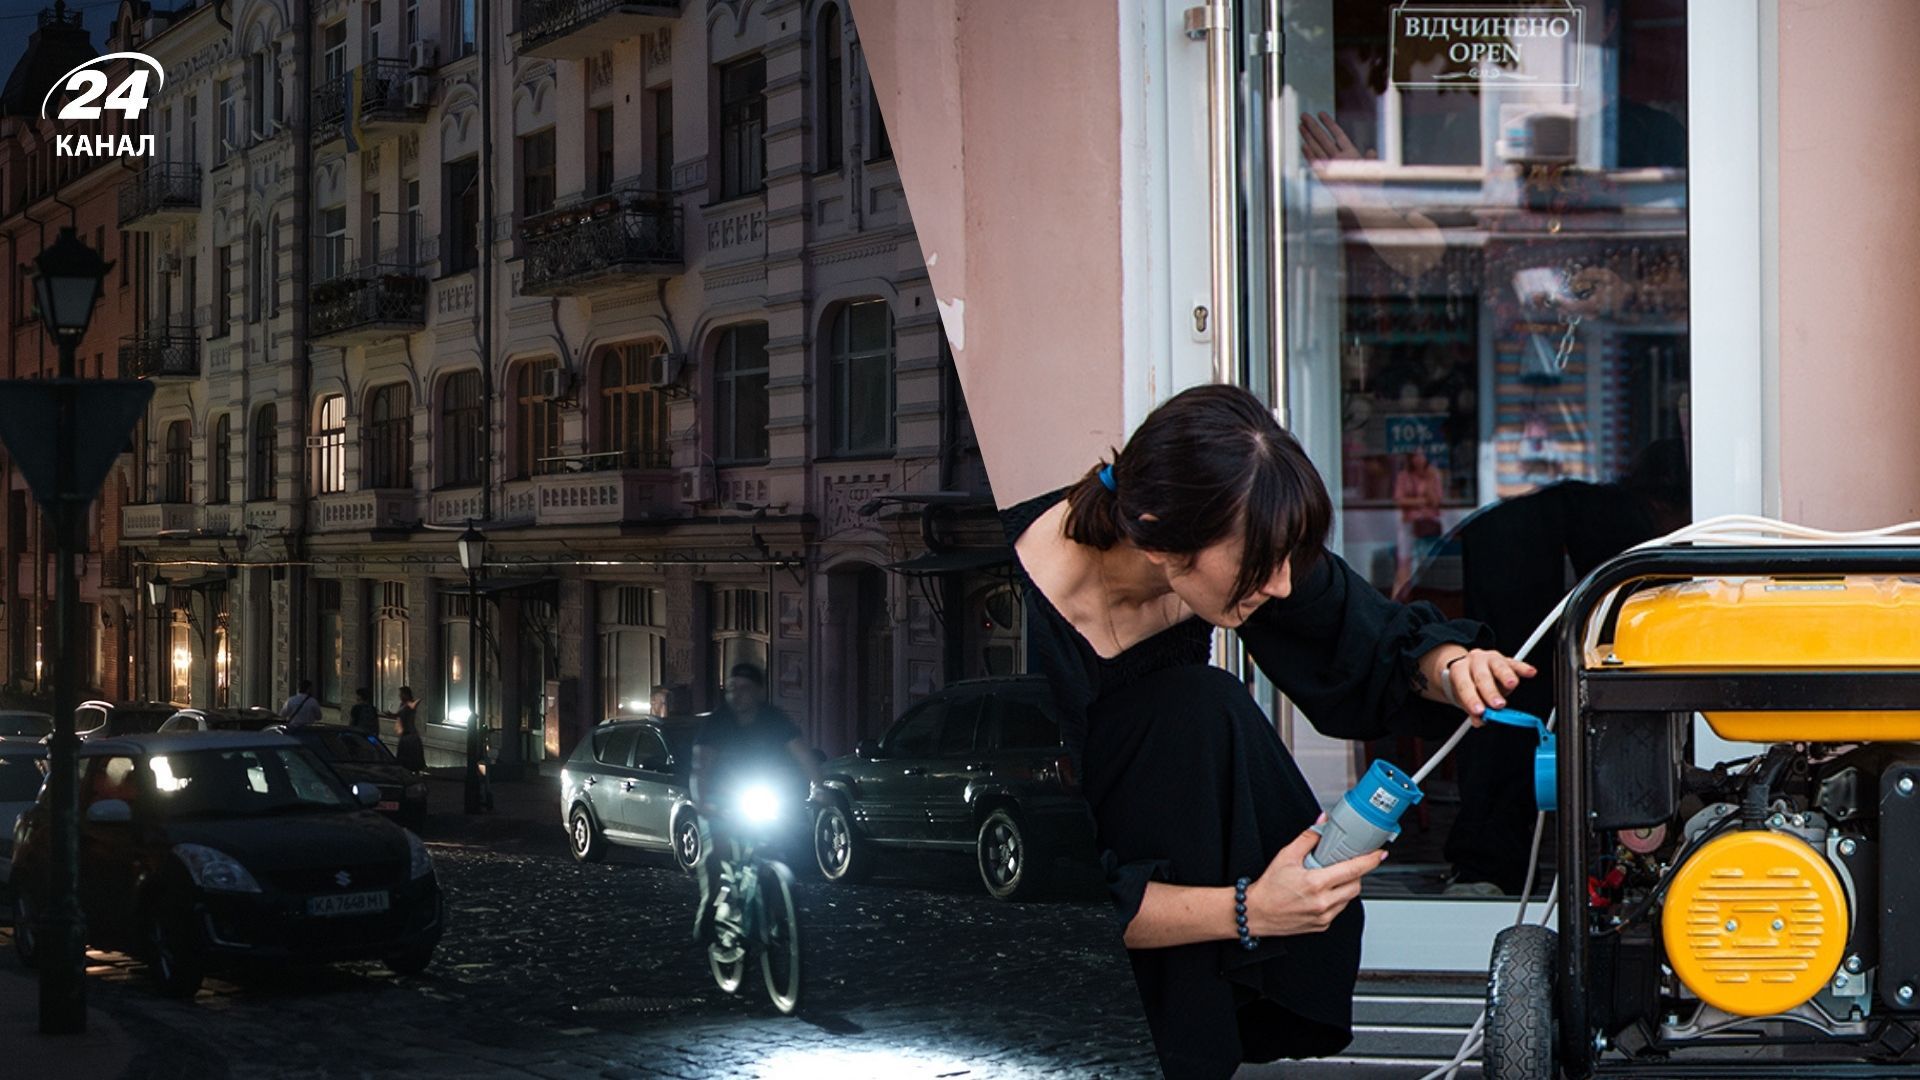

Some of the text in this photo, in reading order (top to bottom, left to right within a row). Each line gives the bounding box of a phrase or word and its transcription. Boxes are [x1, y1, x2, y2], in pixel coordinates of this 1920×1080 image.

[1405, 16, 1570, 40] ВІДЧИНЕНО
[1449, 43, 1523, 63] OPEN
[1391, 423, 1433, 442] 10%
